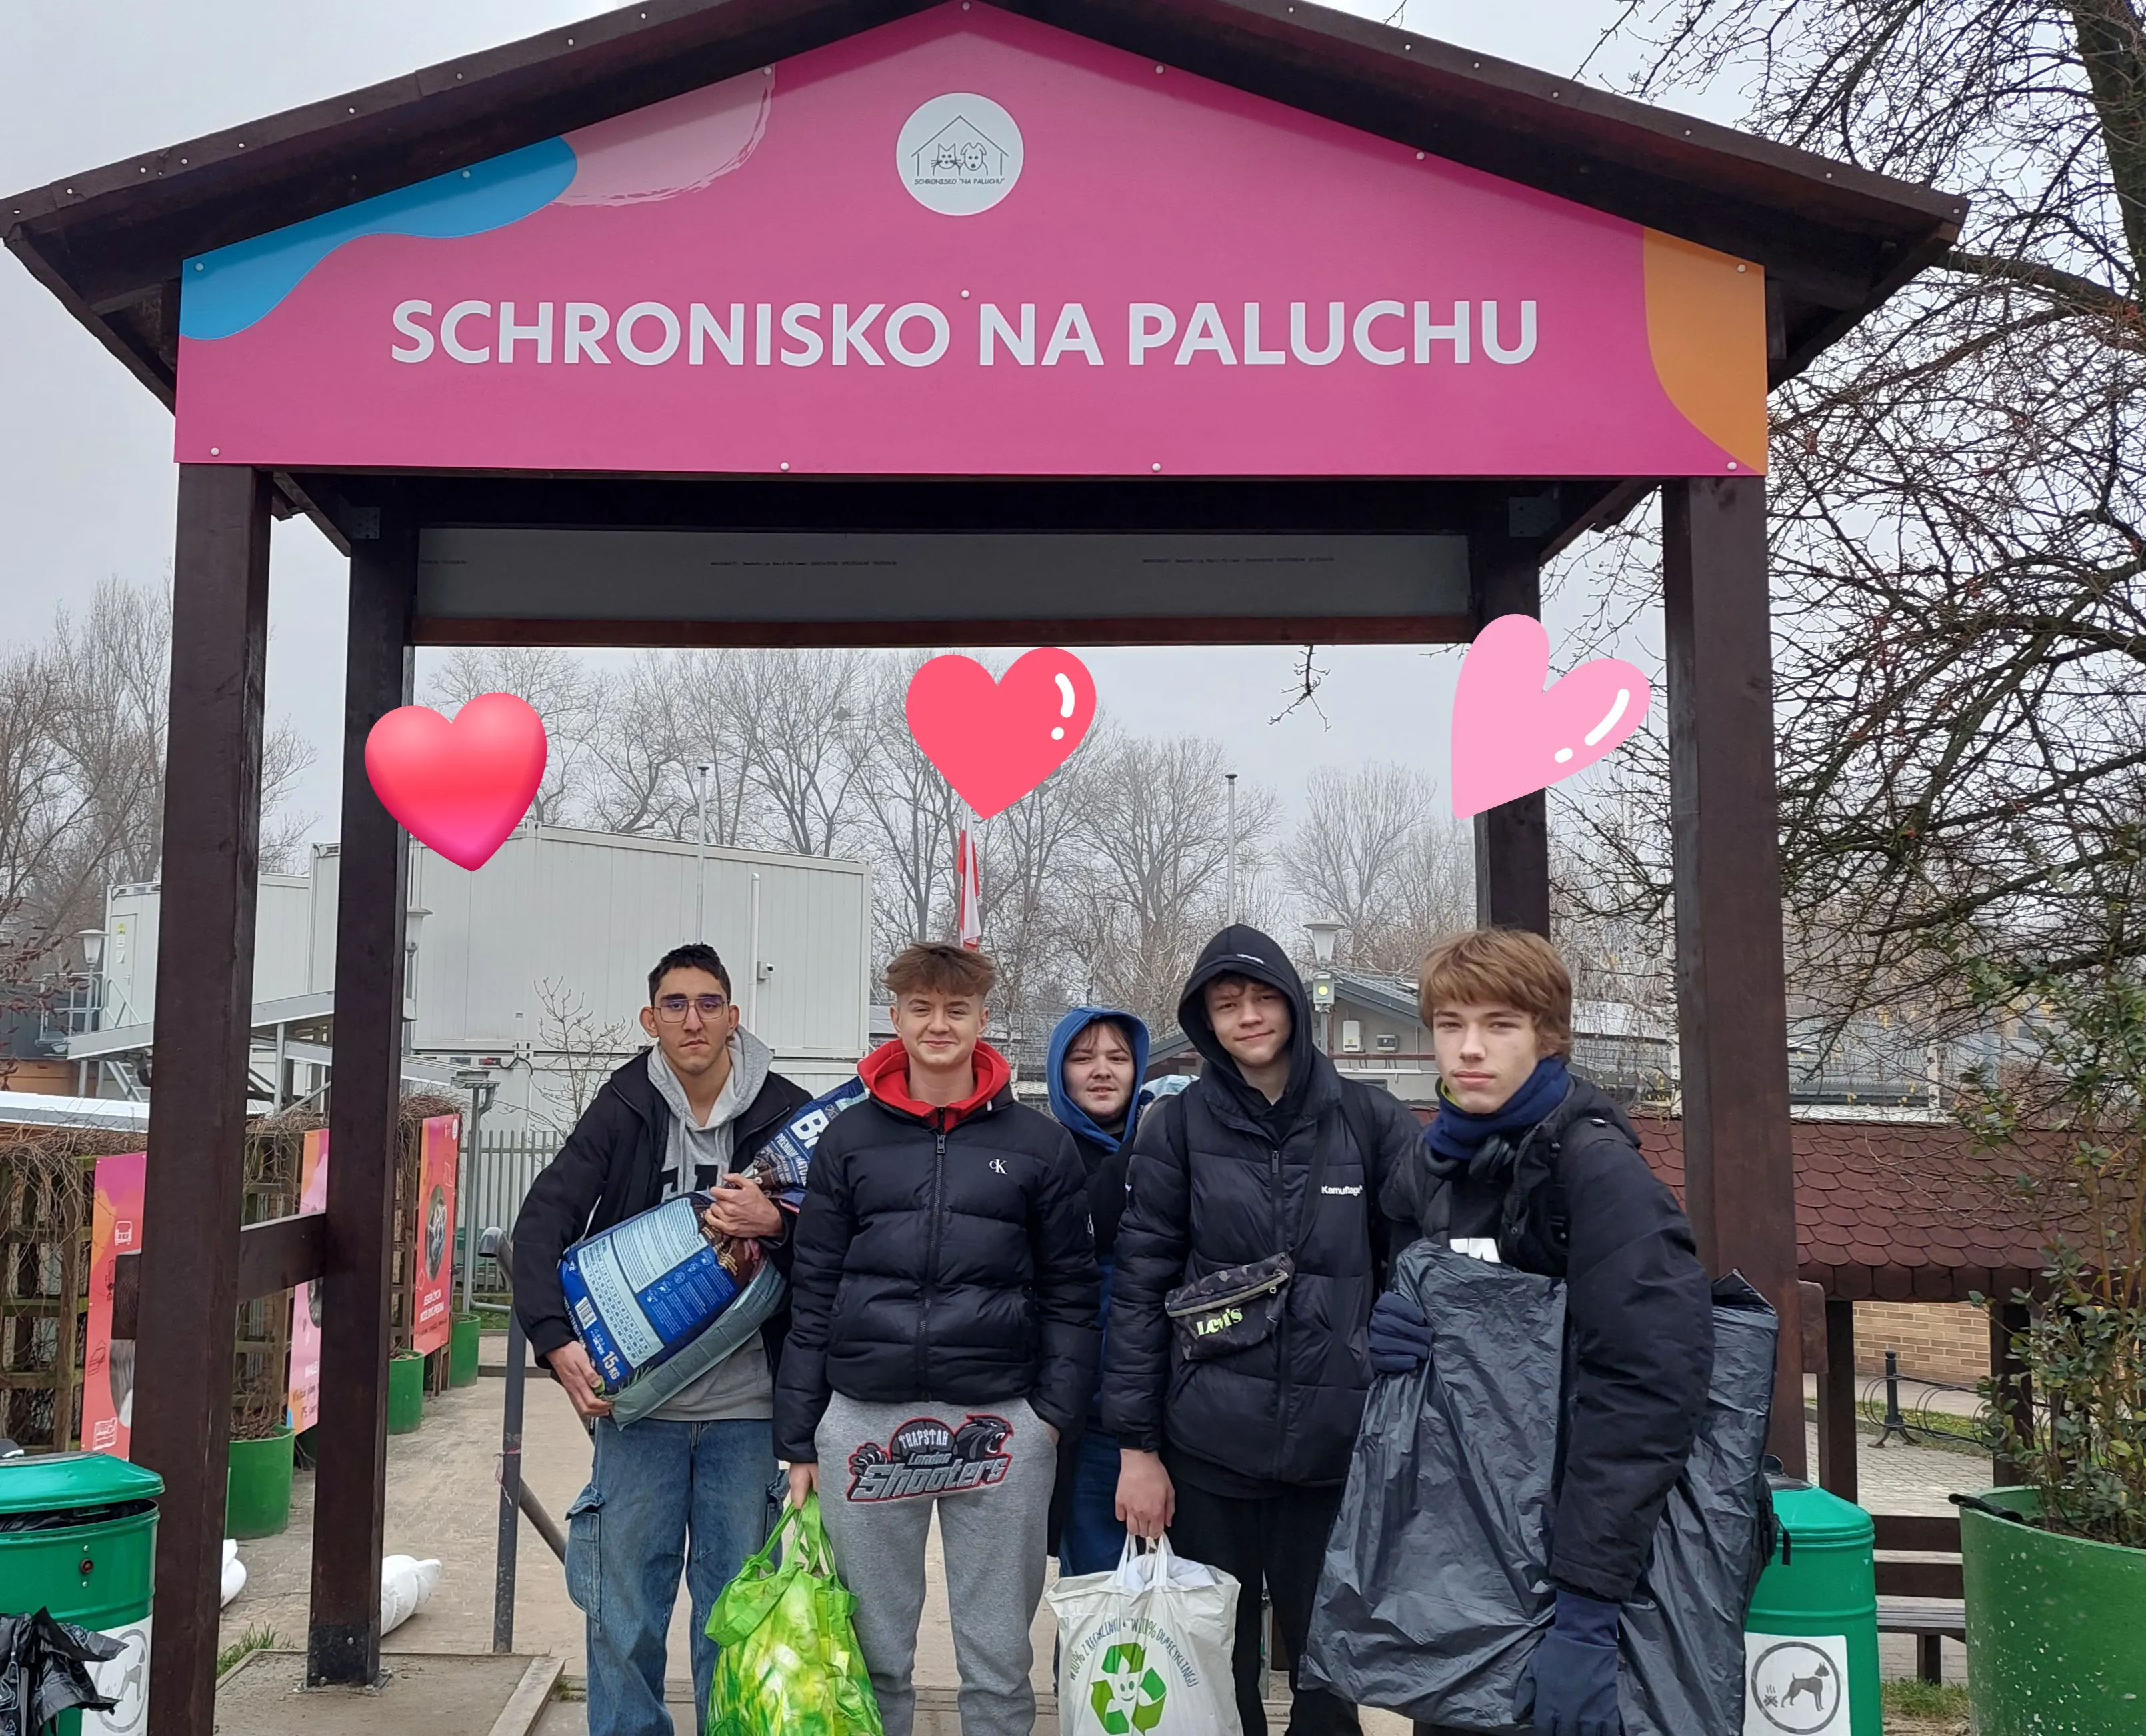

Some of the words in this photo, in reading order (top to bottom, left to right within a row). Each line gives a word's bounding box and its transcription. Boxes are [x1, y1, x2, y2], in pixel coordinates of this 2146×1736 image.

[391, 299, 951, 367] SCHRONISKO
[979, 302, 1105, 366] NA
[1128, 299, 1538, 366] PALUCHU
[1196, 1308, 1243, 1336] Levi's
[898, 1429, 949, 1449] TRAPSTAR
[907, 1452, 953, 1466] London
[851, 1458, 1009, 1499] Shooters
